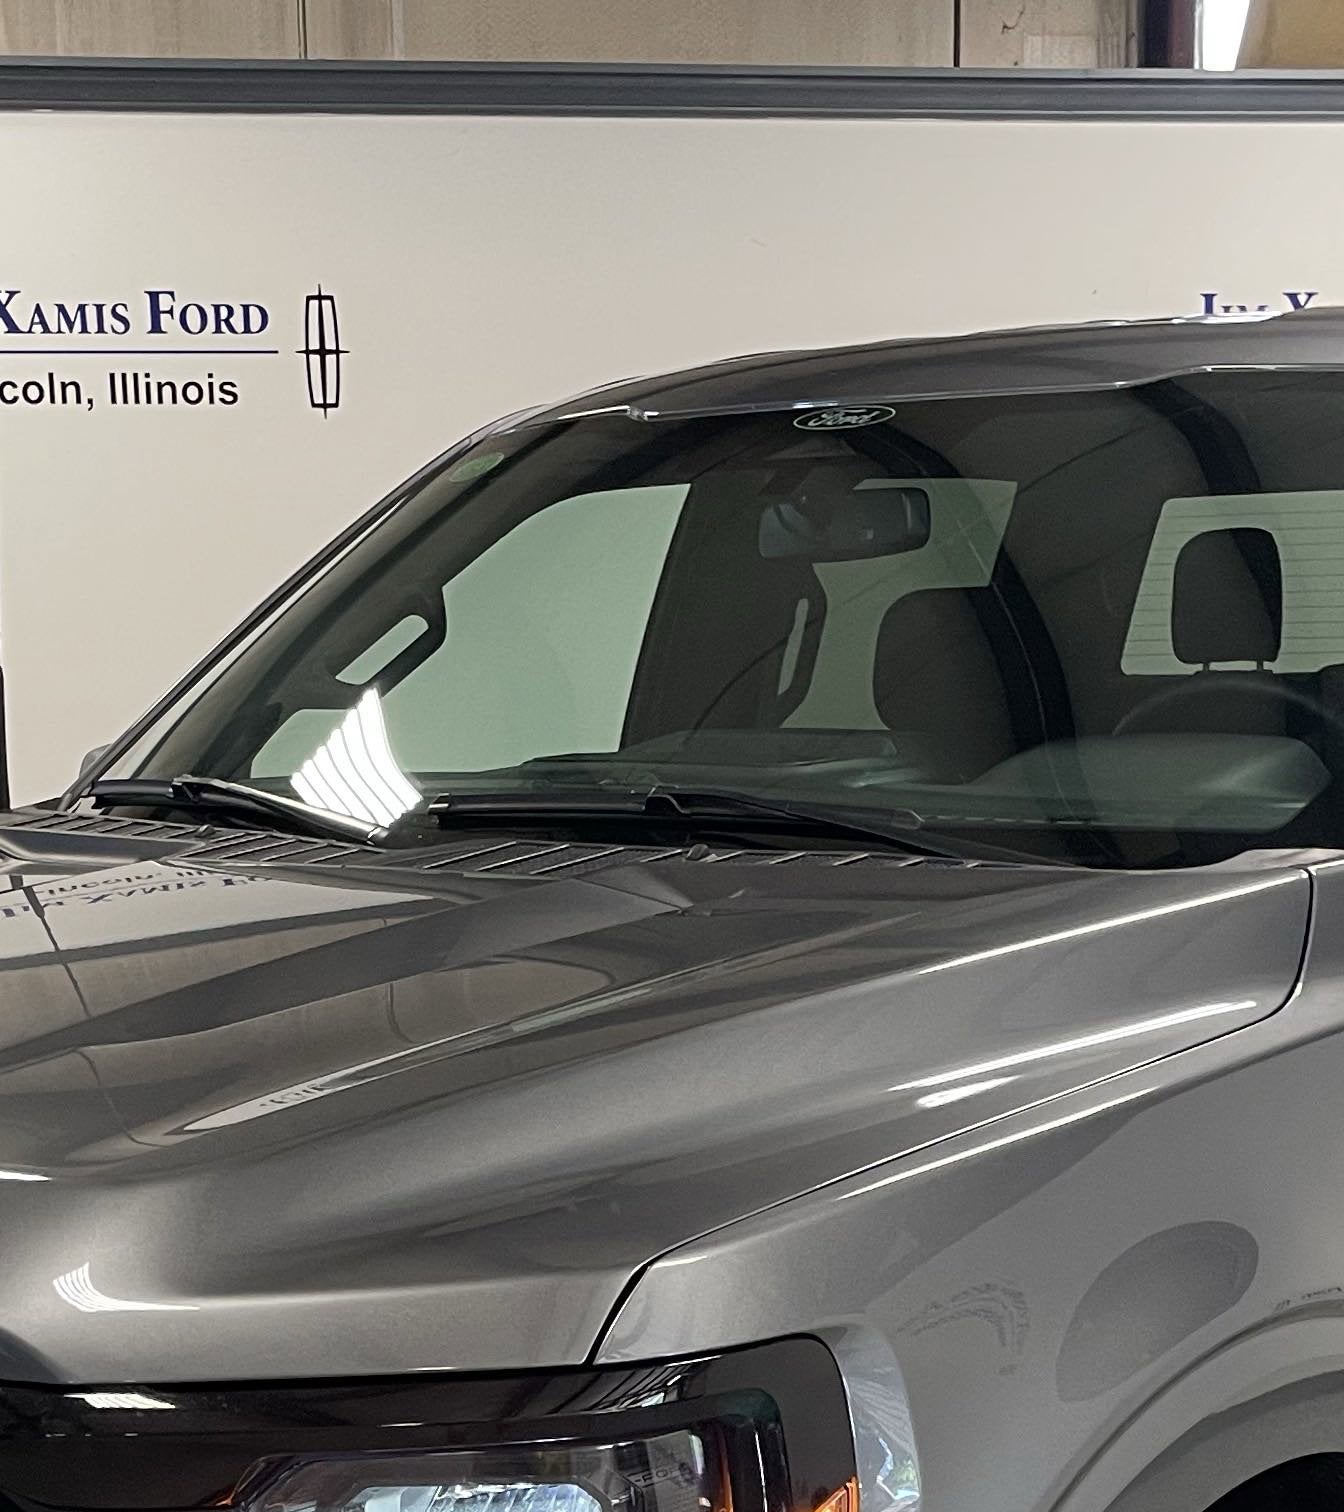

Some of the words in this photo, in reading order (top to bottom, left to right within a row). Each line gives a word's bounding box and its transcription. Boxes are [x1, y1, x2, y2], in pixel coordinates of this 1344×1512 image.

[144, 290, 269, 335] FORD
[109, 372, 239, 406] Illinois
[807, 408, 881, 427] Ford
